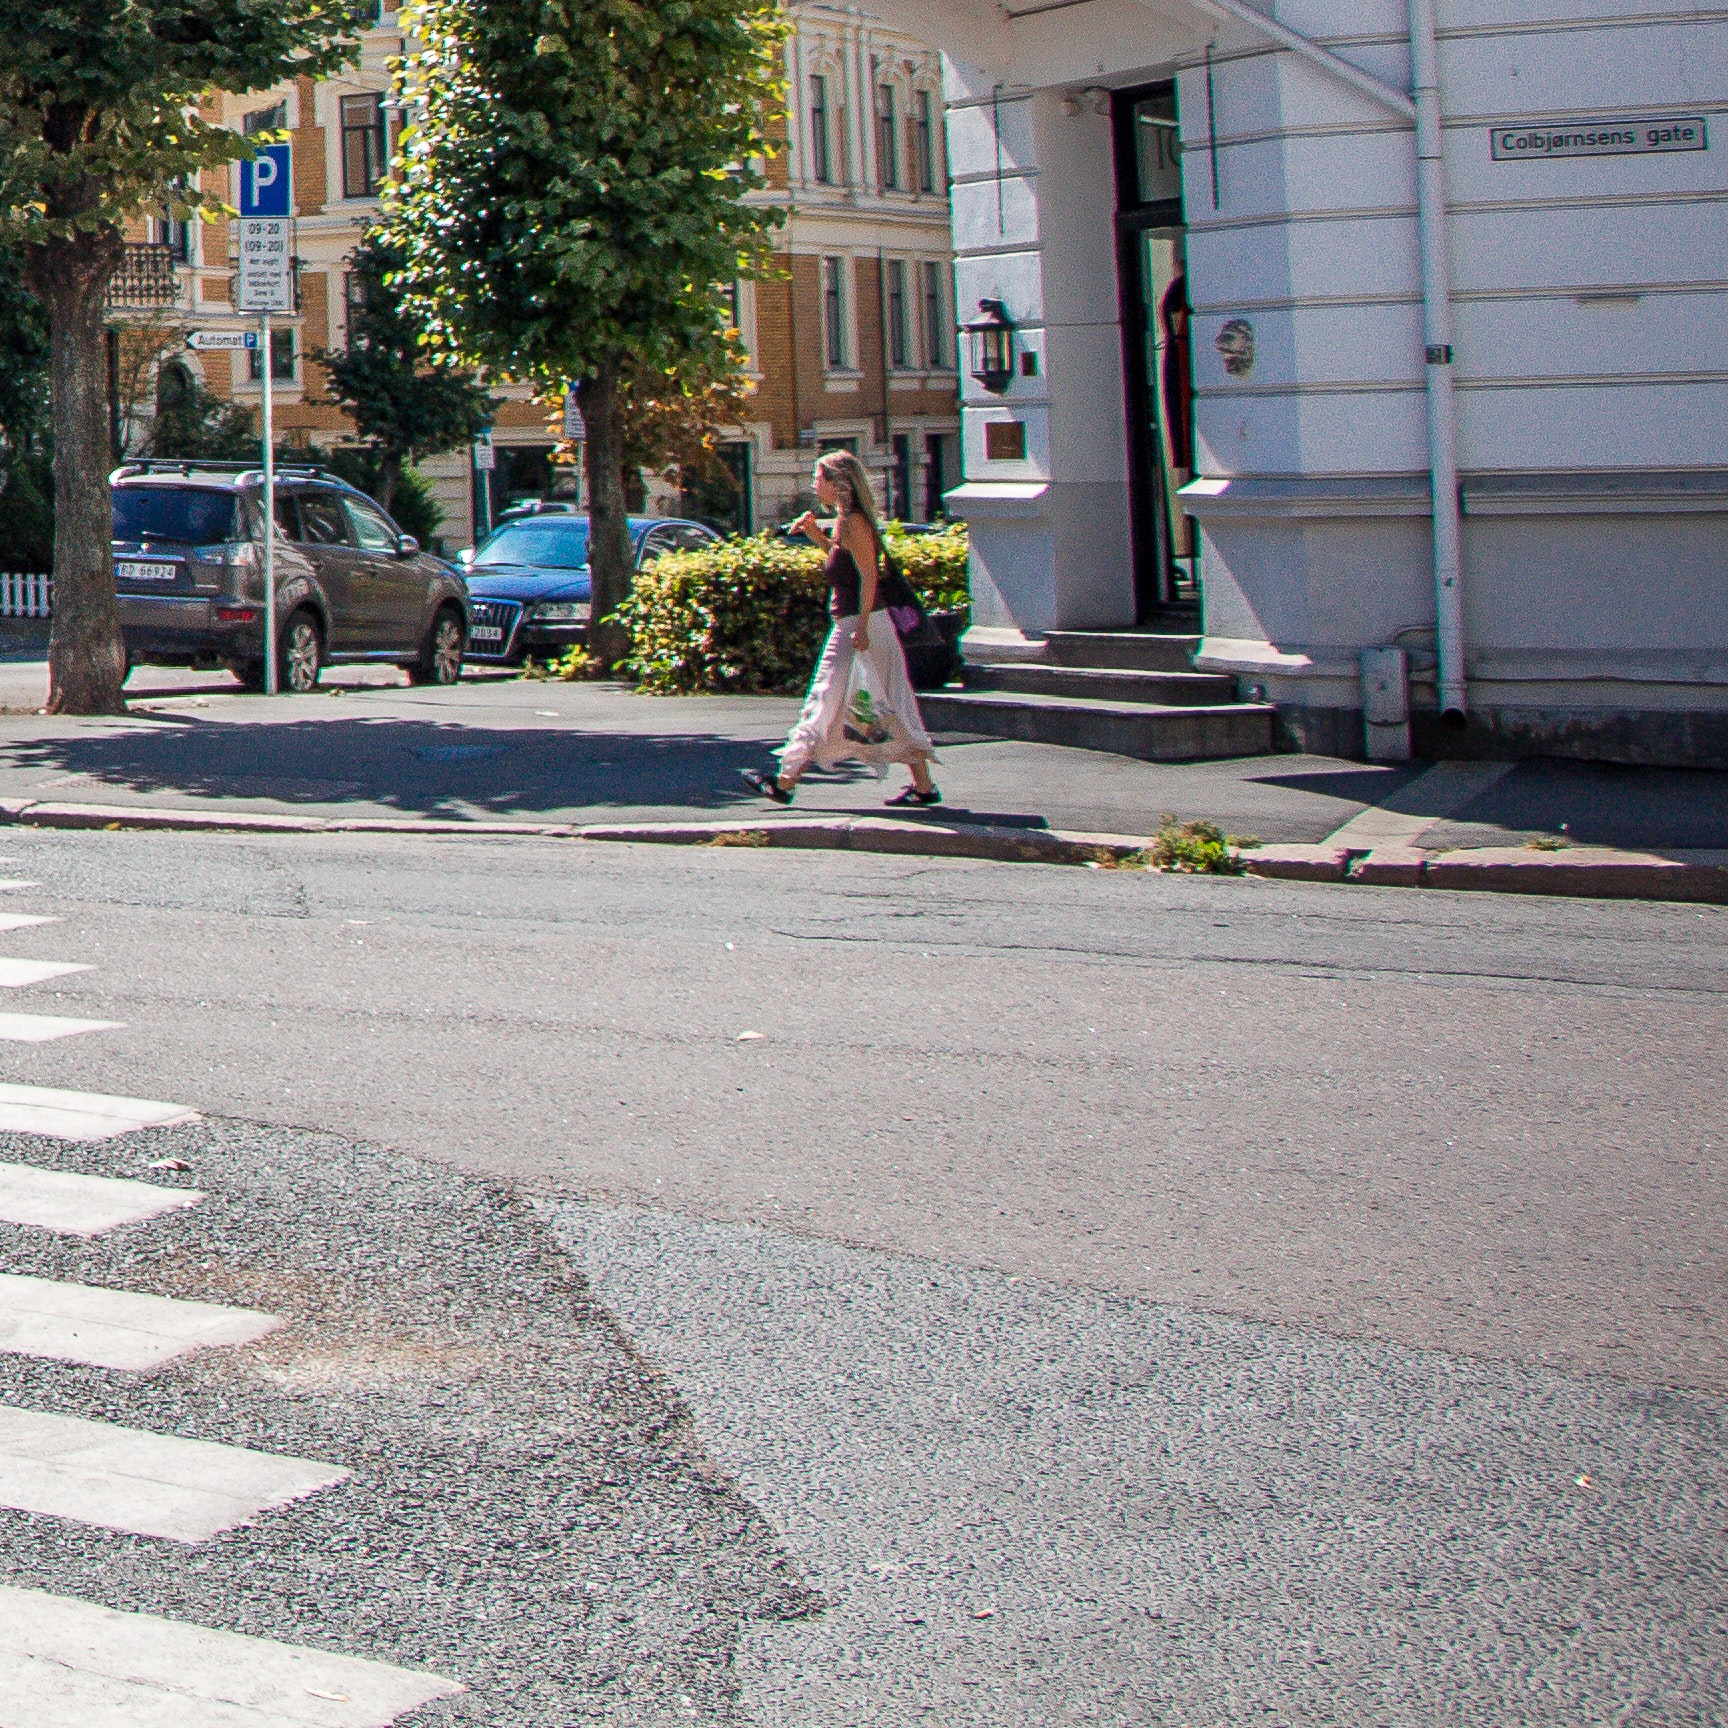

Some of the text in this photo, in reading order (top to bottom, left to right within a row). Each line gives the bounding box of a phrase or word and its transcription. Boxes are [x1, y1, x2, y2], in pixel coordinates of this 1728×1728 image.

[1501, 125, 1695, 152] Colbjørnsens gate
[252, 155, 278, 207] P
